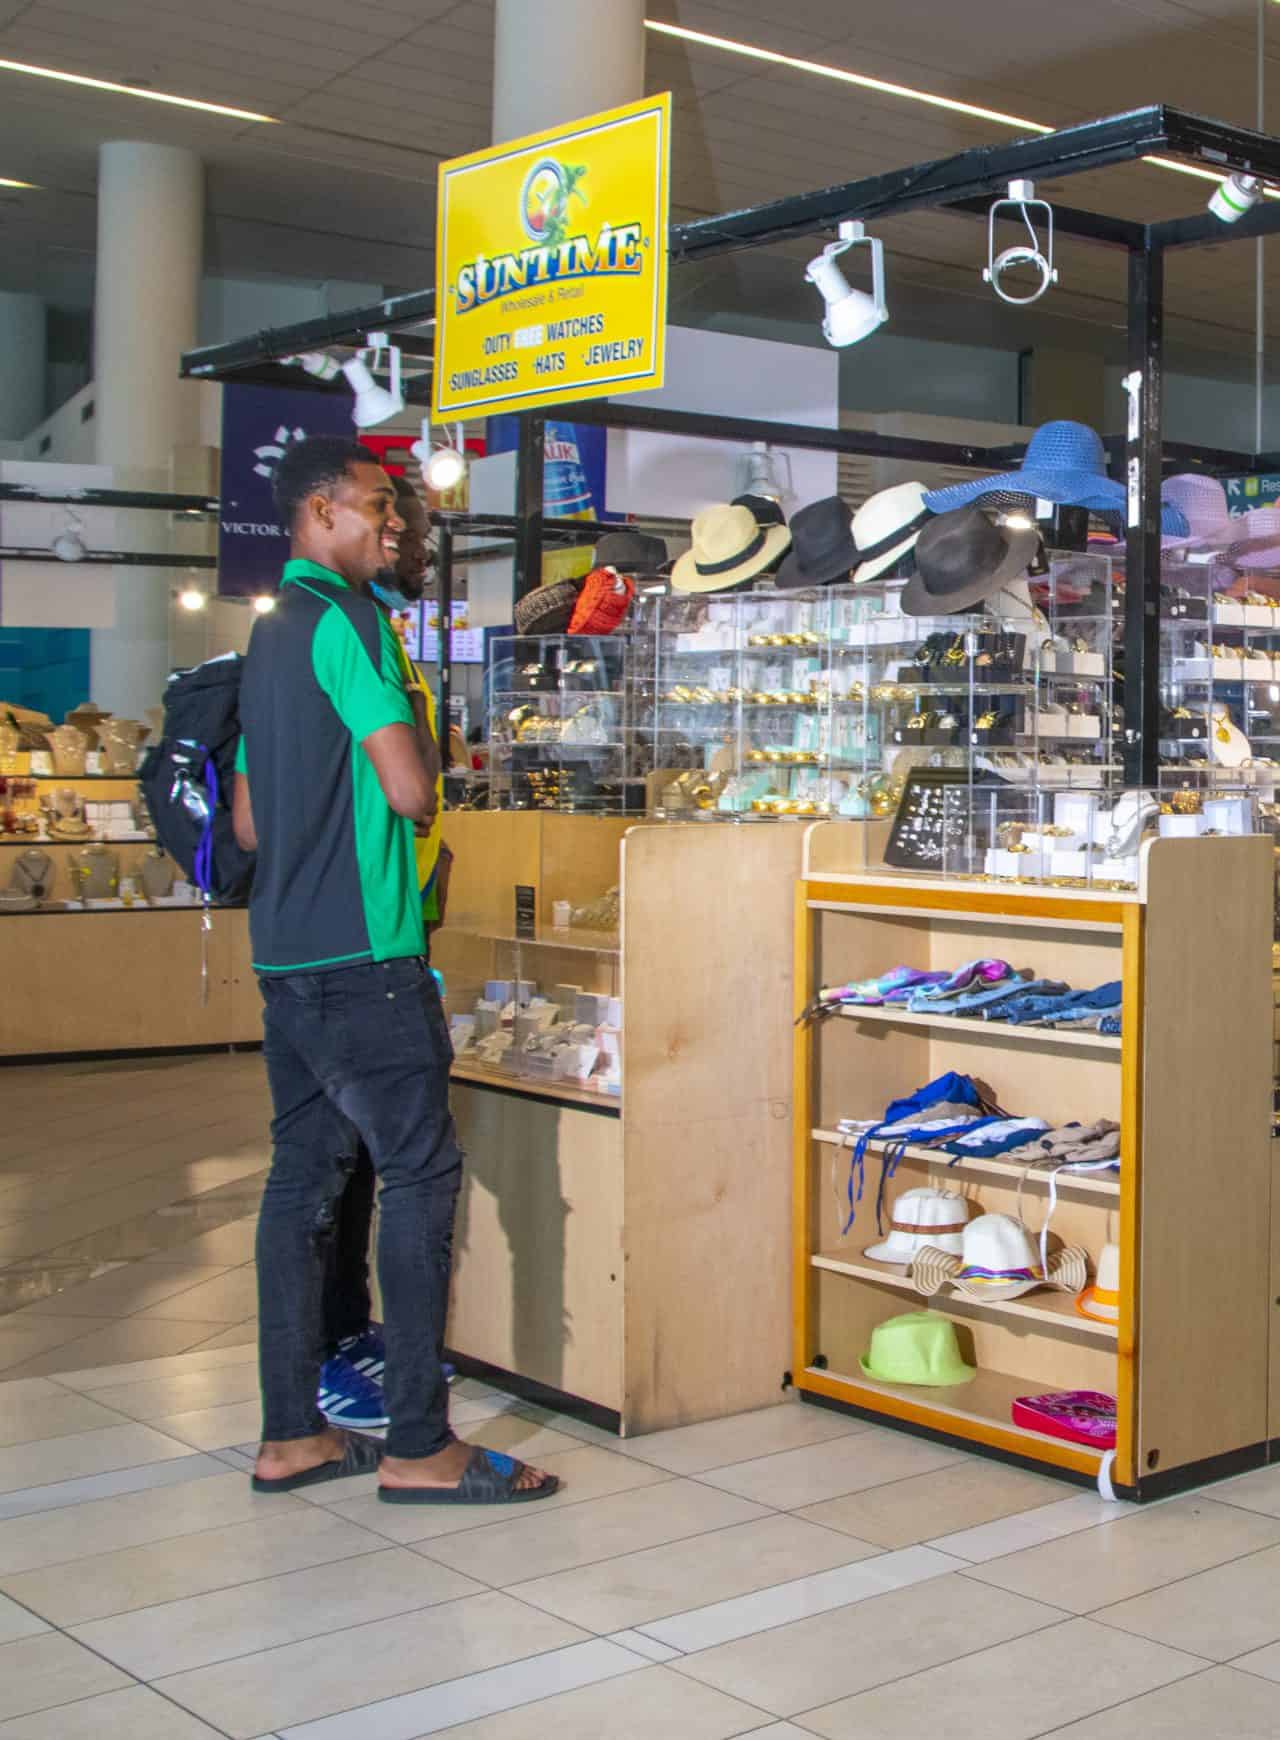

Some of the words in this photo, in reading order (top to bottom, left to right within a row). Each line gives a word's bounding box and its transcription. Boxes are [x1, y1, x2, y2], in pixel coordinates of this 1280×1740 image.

[456, 223, 641, 314] SUNTIME
[547, 314, 604, 342] WATCHES
[450, 362, 518, 391] SUNGLASSES
[535, 352, 565, 374] HATS
[584, 337, 645, 366] JEWELRY
[221, 521, 281, 537] VICTOR
